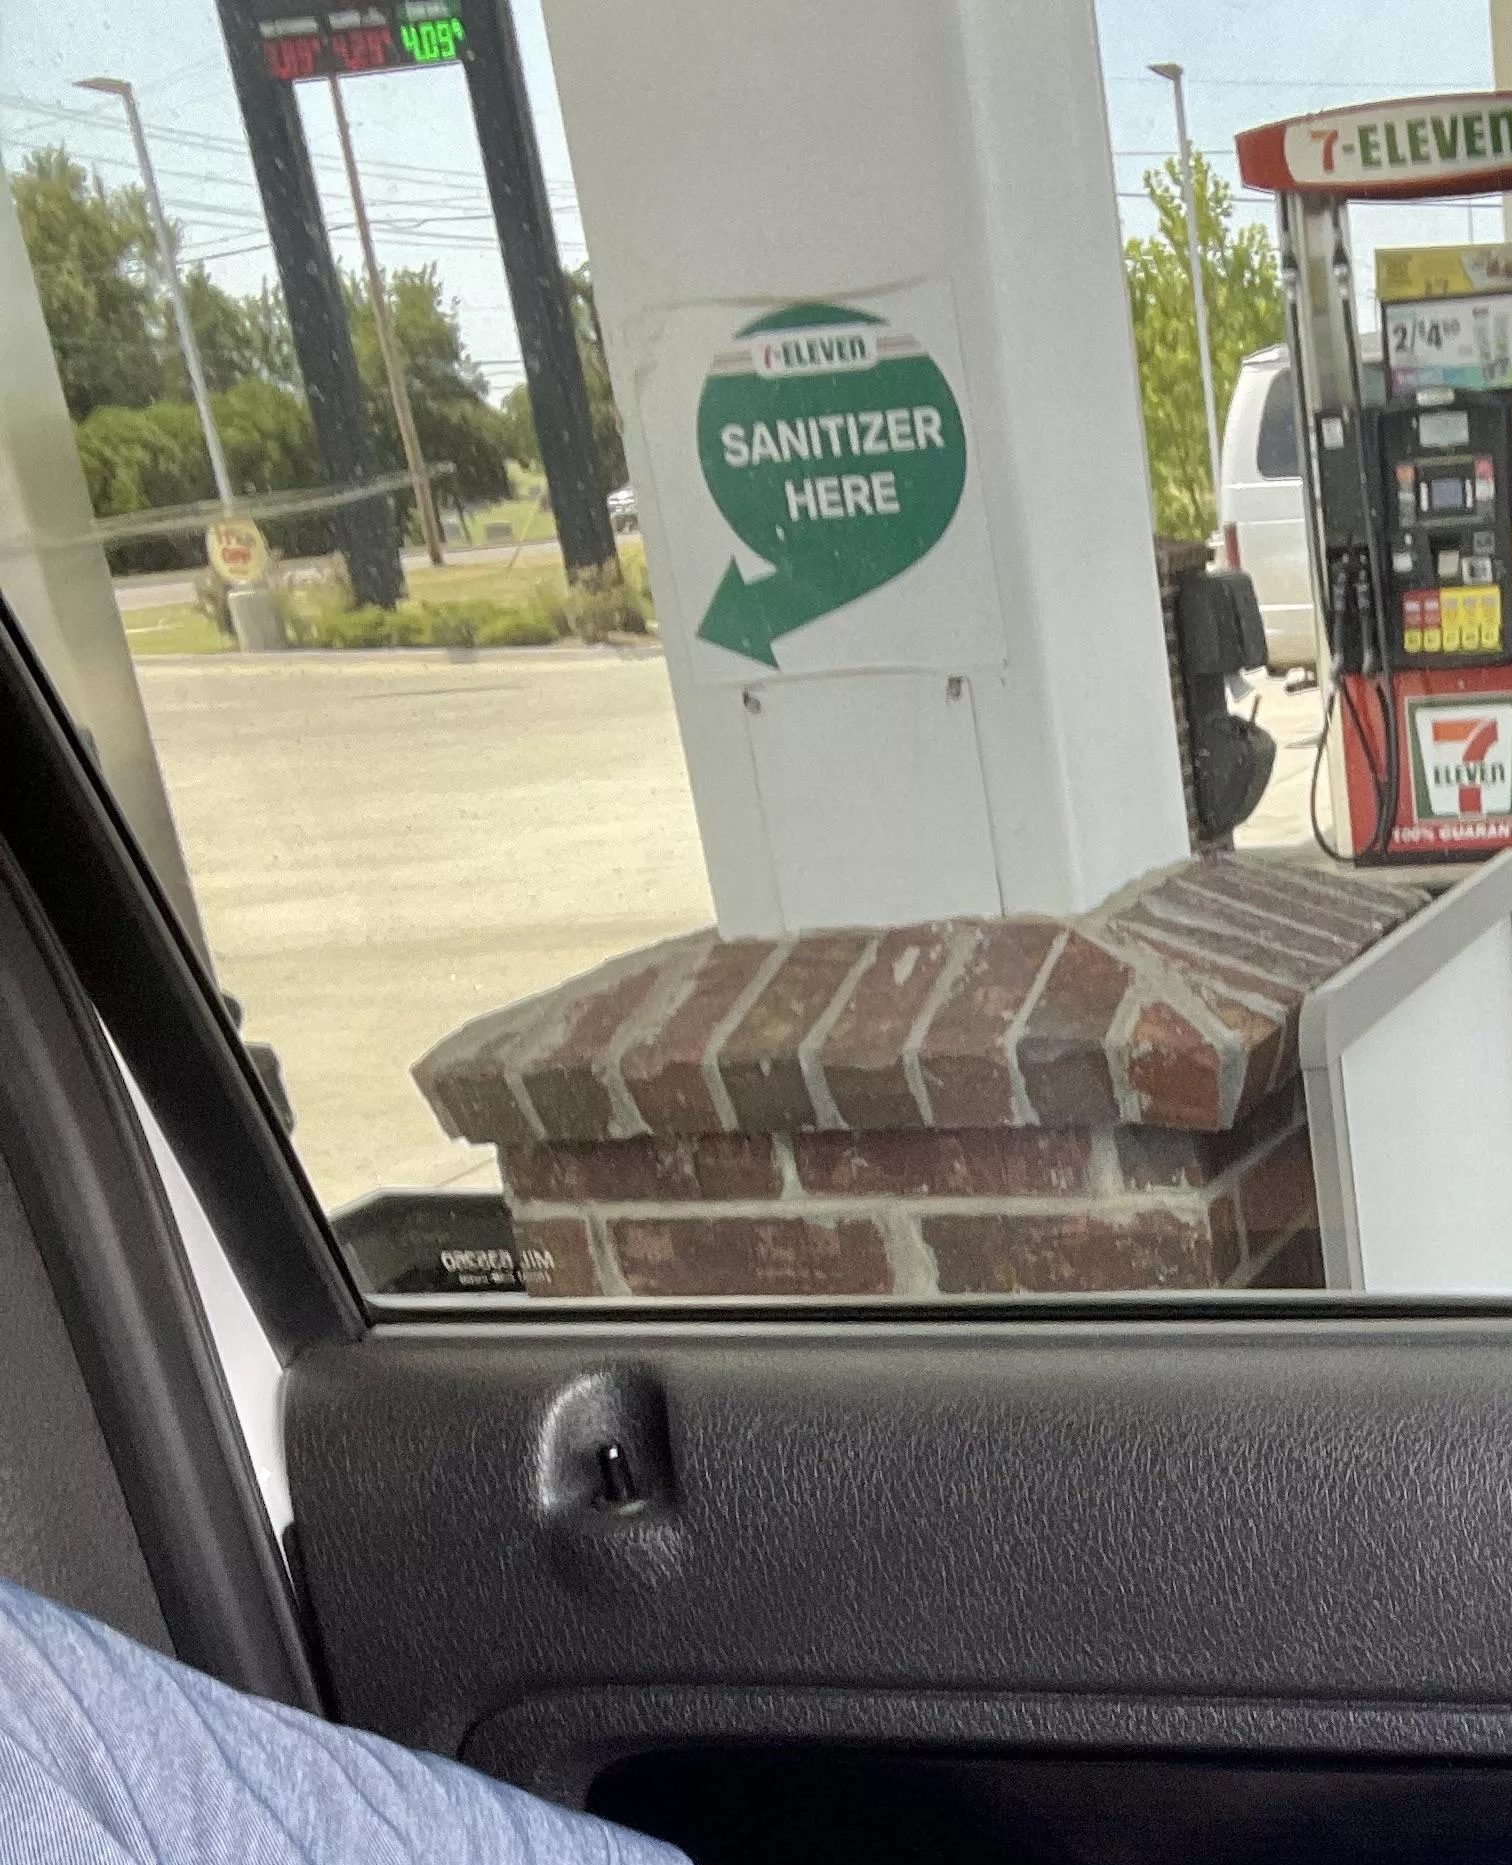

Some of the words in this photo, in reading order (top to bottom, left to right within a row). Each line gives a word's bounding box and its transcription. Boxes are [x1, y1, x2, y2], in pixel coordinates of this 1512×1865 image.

[720, 405, 945, 469] SANITIZER
[784, 471, 901, 522] HERE
[1431, 718, 1499, 815] 7
